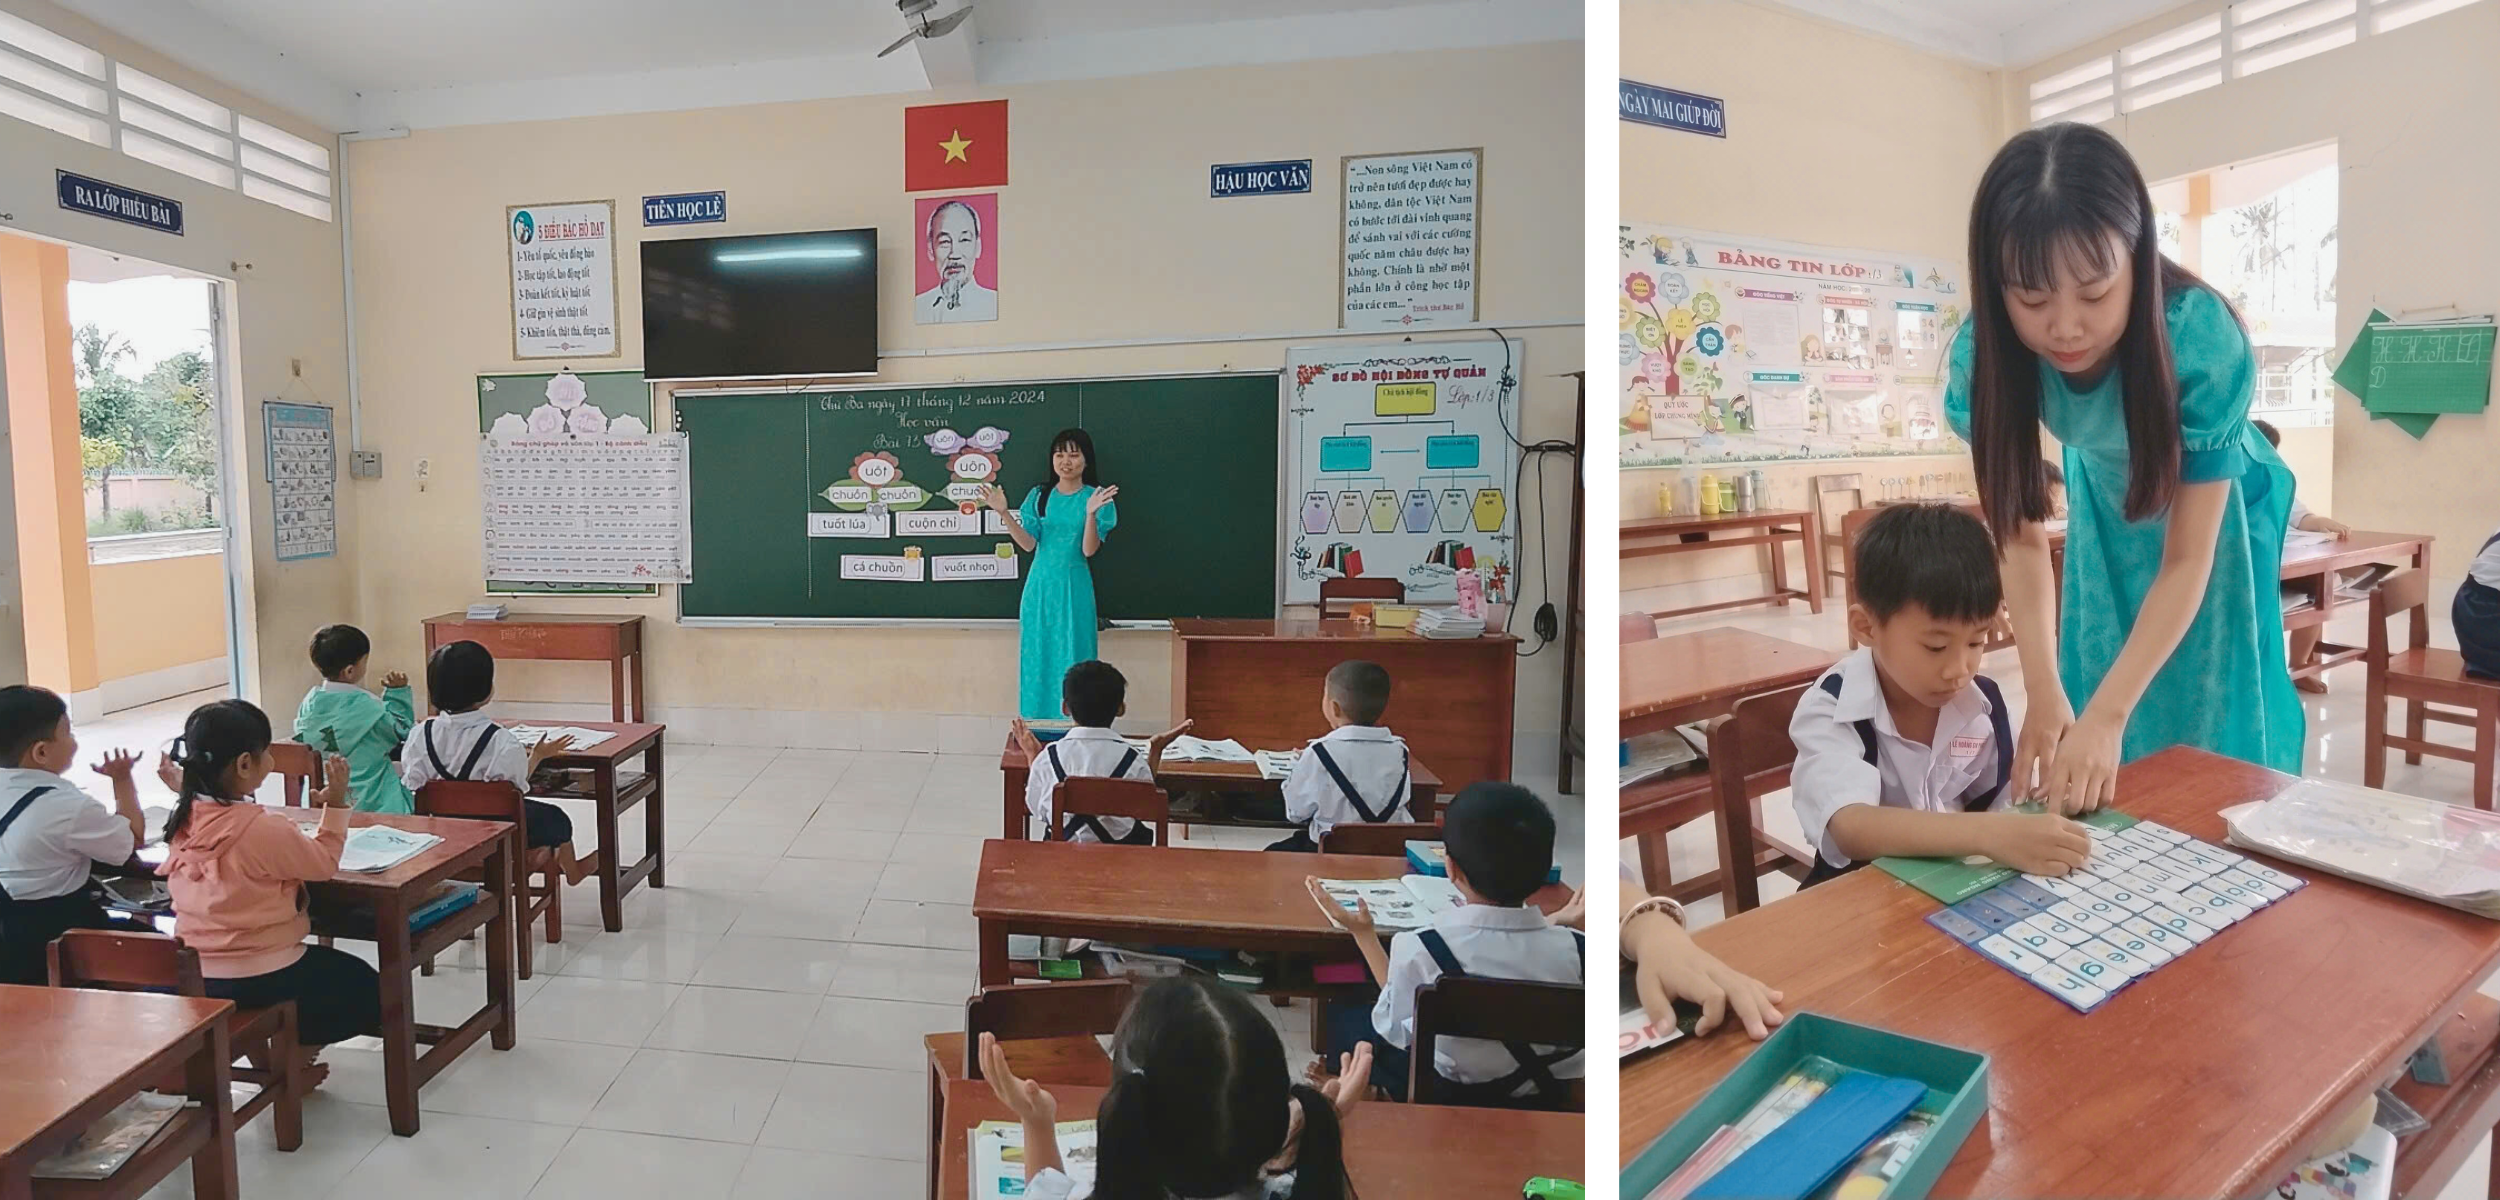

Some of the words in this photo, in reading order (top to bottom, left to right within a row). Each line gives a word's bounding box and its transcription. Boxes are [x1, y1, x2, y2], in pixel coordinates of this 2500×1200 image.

[1651, 97, 1674, 120] MAI
[1675, 100, 1701, 125] GIÚP
[1702, 104, 1722, 129] ĐỜI
[1387, 163, 1409, 175] sông
[1412, 161, 1433, 173] Việt
[1436, 160, 1459, 172] Nam
[1461, 159, 1473, 170] có
[1215, 171, 1244, 194] HẬU
[1247, 171, 1277, 192] HỌC
[1280, 166, 1309, 187] VĂN
[1367, 182, 1385, 192] nên
[1408, 178, 1427, 192] đẹp
[1429, 178, 1453, 190] được
[1455, 177, 1471, 189] hay
[75, 185, 95, 207] RA
[95, 188, 120, 212] LỚP
[151, 201, 171, 225] BÀI
[1384, 197, 1403, 209] dân
[1406, 196, 1422, 208] tộc
[1425, 195, 1446, 207] Việt
[1449, 194, 1472, 205] Nam
[677, 201, 704, 221] HỌC
[1348, 216, 1360, 227] có
[1402, 213, 1418, 224] đài
[1442, 211, 1472, 224] quang
[538, 225, 542, 239] 5
[1363, 231, 1386, 243] sánh
[1389, 230, 1402, 242] vai
[1422, 229, 1439, 240] các
[1347, 249, 1371, 263] quốc
[1374, 249, 1396, 259] năm
[1400, 247, 1422, 258] châu
[1426, 246, 1450, 257] được
[1453, 245, 1470, 257] hay
[1383, 264, 1413, 275] Chính
[1416, 263, 1425, 274] là
[1718, 249, 1781, 269] BẢNG
[1787, 259, 1823, 274] TIN
[1830, 262, 1866, 278] LỚP
[1405, 281, 1429, 292] công
[1432, 279, 1449, 291] học
[1365, 299, 1381, 310] các
[1332, 370, 1349, 382] SƠ
[1351, 368, 1368, 382] ĐỒ
[1371, 368, 1393, 383] HỘI
[868, 398, 896, 416] ngày
[917, 390, 954, 414] tháng
[958, 393, 972, 406] 12
[1008, 390, 1045, 405] 2024
[959, 460, 987, 472] uôn
[823, 517, 846, 529] tuốt
[849, 517, 866, 529] lúa
[908, 517, 937, 530] cuộn
[940, 516, 957, 528] chỉ
[853, 561, 866, 572] cá
[869, 560, 903, 573] chuồn
[969, 562, 995, 573] nhọn
